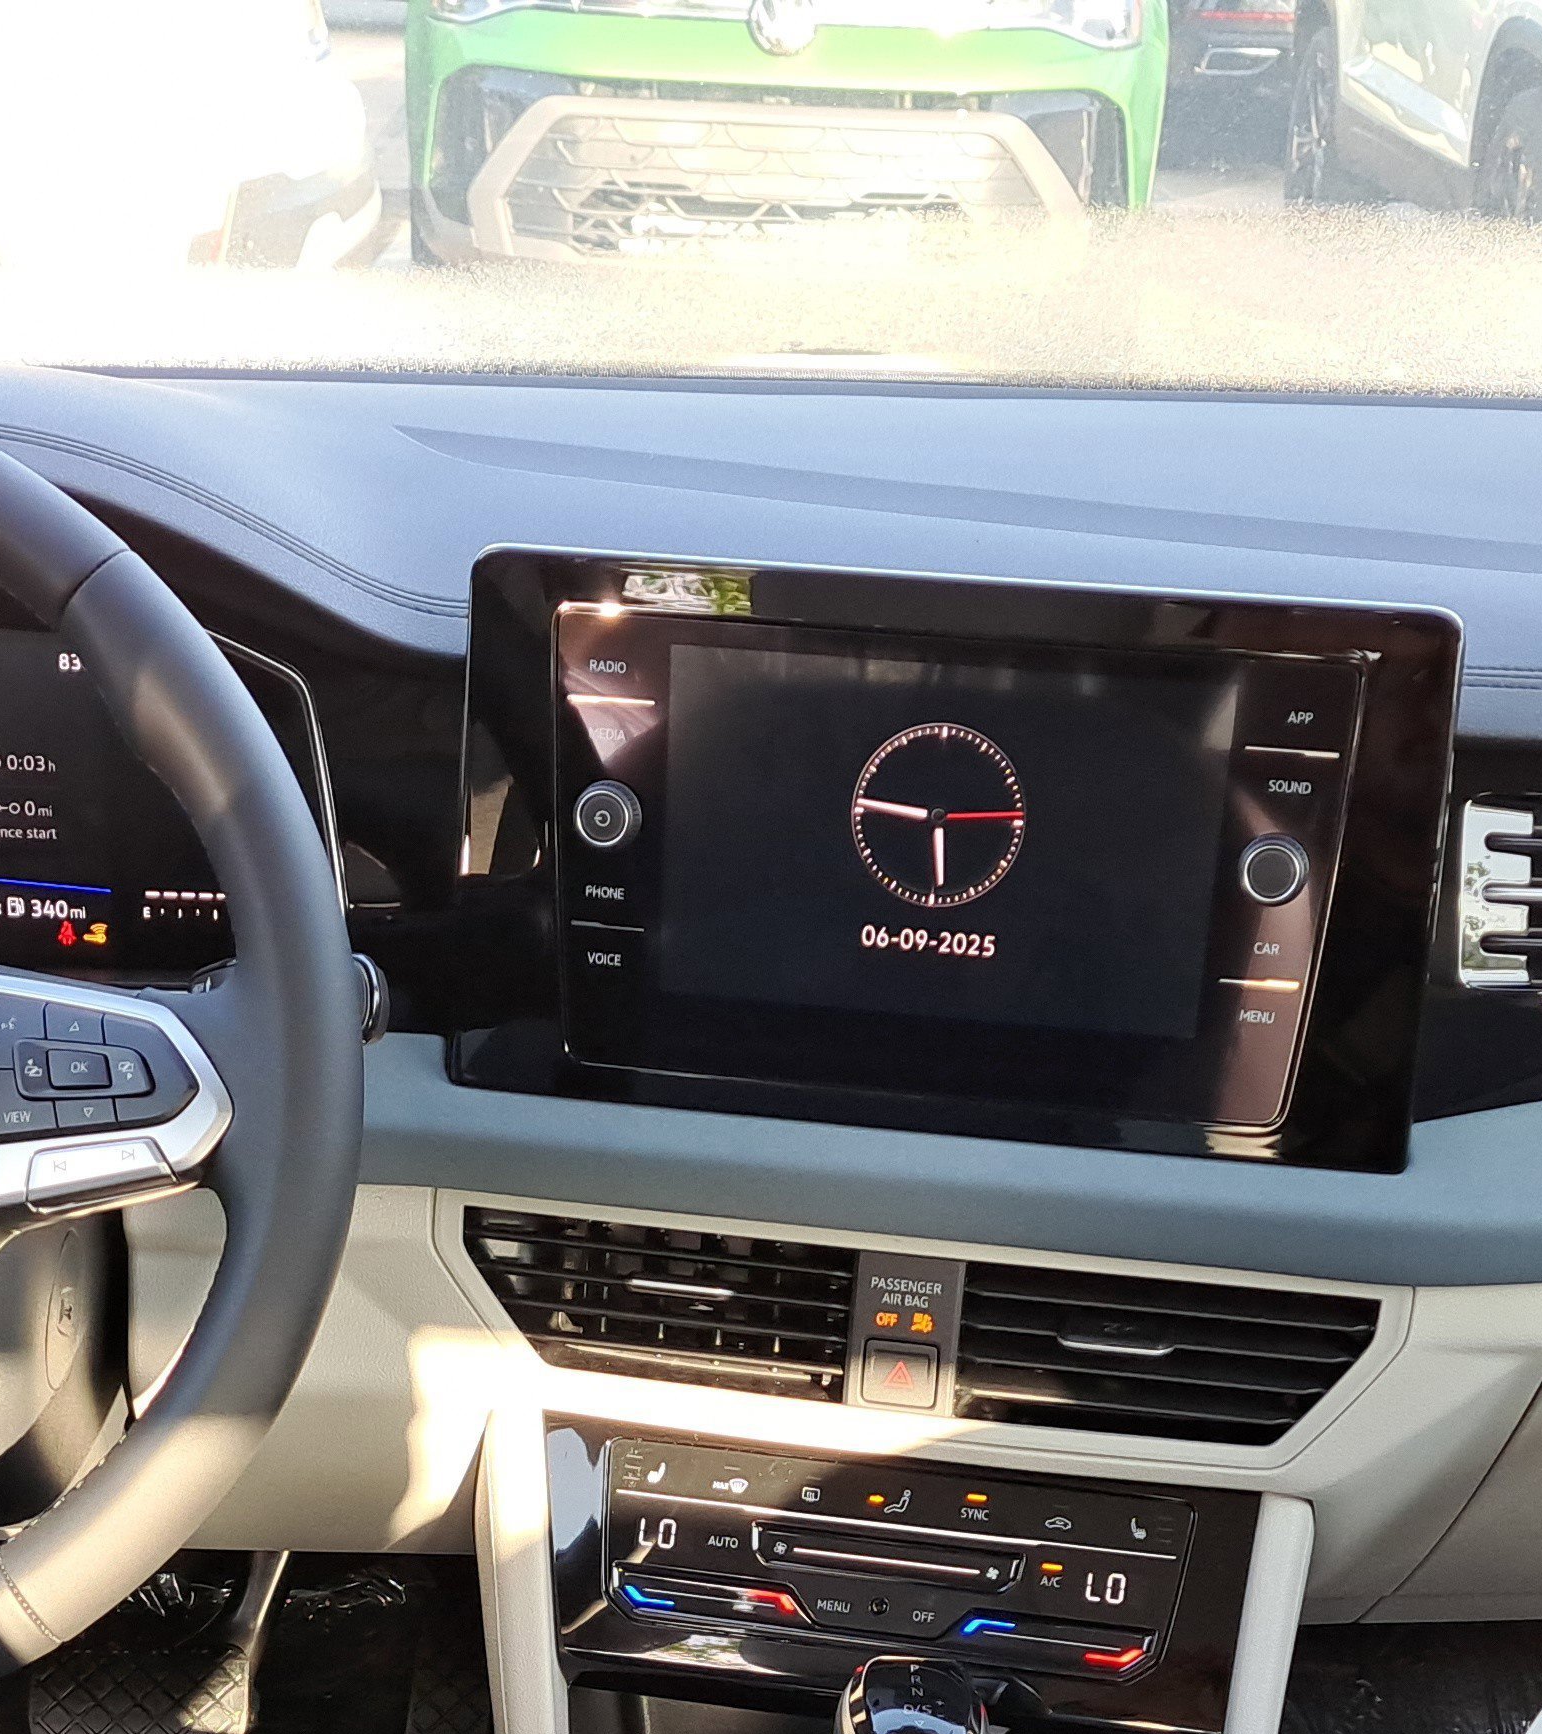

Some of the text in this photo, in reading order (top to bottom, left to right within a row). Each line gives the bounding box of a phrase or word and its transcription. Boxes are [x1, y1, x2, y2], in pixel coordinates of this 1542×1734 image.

[589, 658, 627, 675] RADIO
[1287, 711, 1314, 725] APP
[589, 727, 626, 741] MEDIA
[7, 755, 46, 771] 0:03
[1268, 779, 1312, 795] SOUND
[38, 805, 53, 817] mi
[26, 827, 57, 840] start
[585, 884, 625, 900] PHONE
[31, 900, 86, 919] 340 mi
[143, 907, 151, 919] E
[861, 924, 996, 958] 06-09-2025
[1254, 942, 1280, 955] CAR
[587, 951, 622, 967] VOICE
[1239, 1010, 1275, 1024] MENU
[70, 1061, 88, 1074] OK
[3, 1111, 32, 1124] VIEW
[870, 1276, 943, 1295] PASSENGER
[881, 1293, 929, 1309] AIR BAG
[876, 1311, 899, 1327] OFF
[960, 1507, 990, 1522] SYNC
[638, 1517, 677, 1550] LO
[707, 1535, 739, 1549] AUTO
[1040, 1575, 1062, 1589] A/C
[1085, 1572, 1126, 1604] LO
[816, 1598, 852, 1614] MENU
[912, 1610, 935, 1624] OFF
[911, 1687, 924, 1697] N
